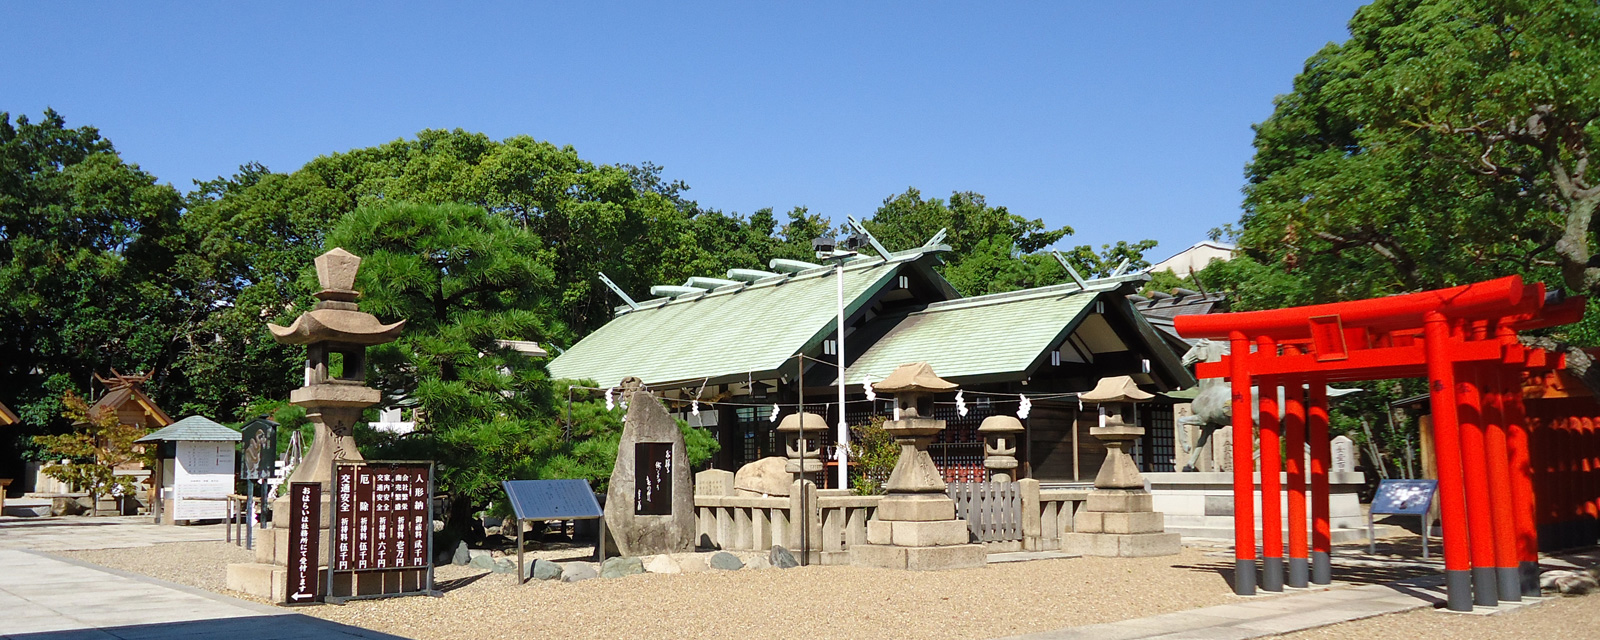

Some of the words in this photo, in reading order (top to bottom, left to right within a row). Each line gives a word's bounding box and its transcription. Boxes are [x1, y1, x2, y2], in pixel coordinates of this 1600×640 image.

[340, 473, 351, 512] 交通安全
[360, 473, 370, 512] 厄除
[376, 473, 384, 511] 交通安全
[383, 473, 391, 511] 家内安全
[414, 473, 424, 511] 人形納
[298, 486, 311, 593] おはらいは社務所にて受付します
